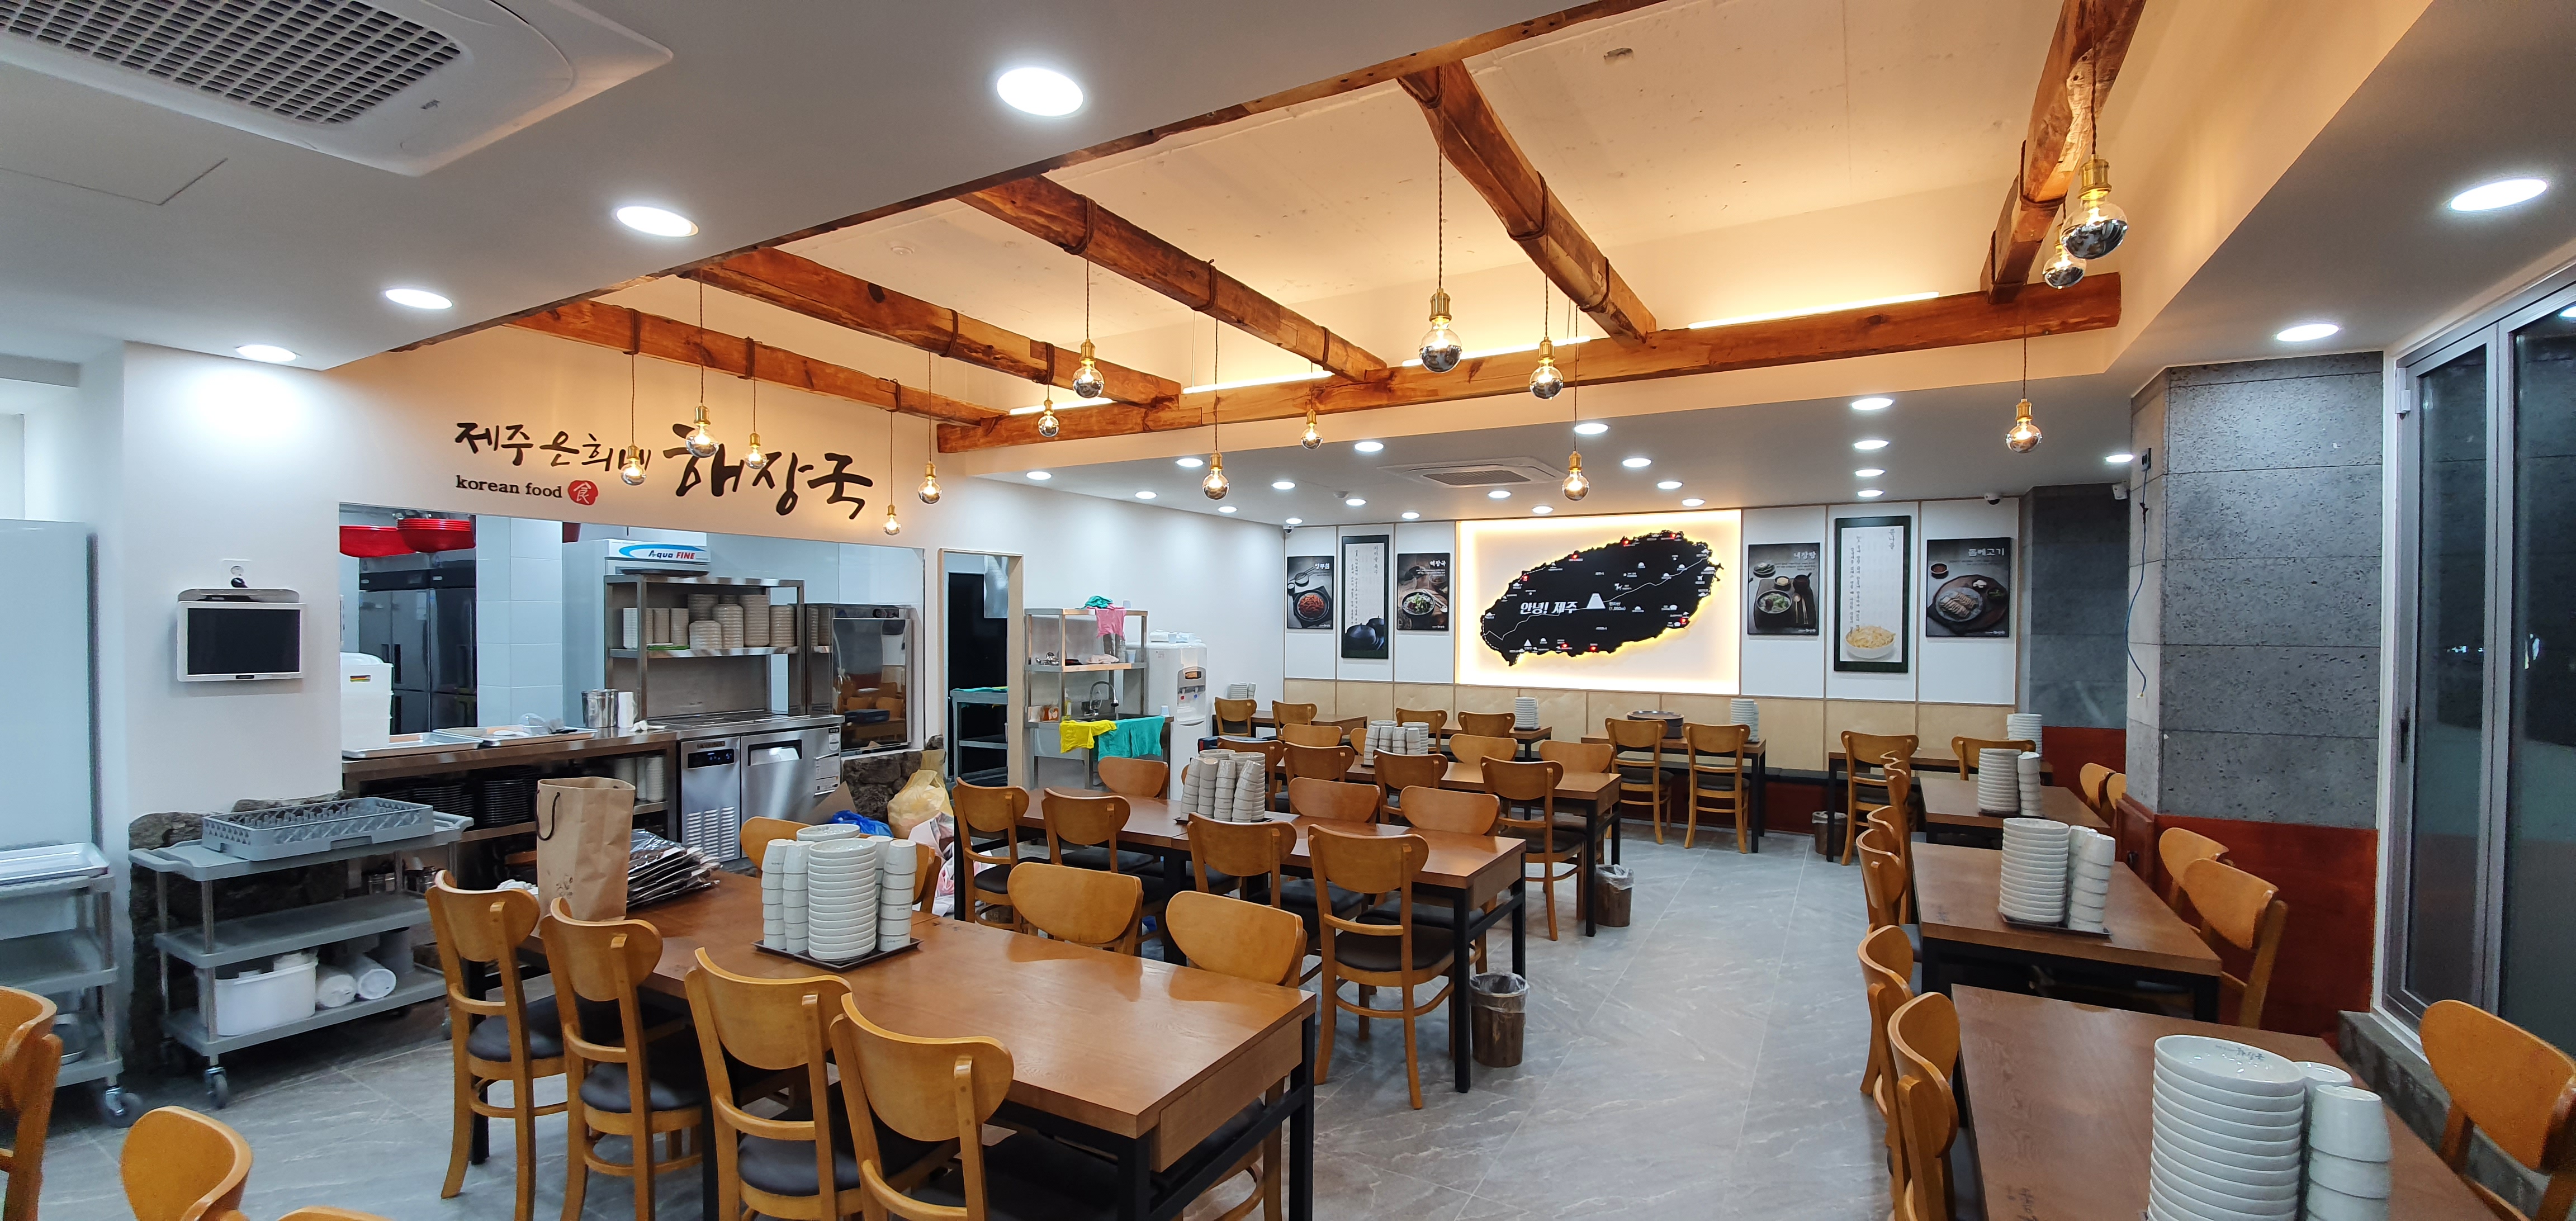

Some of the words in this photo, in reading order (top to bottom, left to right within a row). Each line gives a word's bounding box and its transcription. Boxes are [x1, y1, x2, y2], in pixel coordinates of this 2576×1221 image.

[454, 422, 533, 466] 제주
[455, 475, 520, 494] korean
[525, 482, 563, 499] food
[648, 550, 674, 559] Aqua
[676, 551, 695, 560] FINE
[1520, 602, 1550, 614] 안녕!
[1551, 601, 1578, 614] 제주
